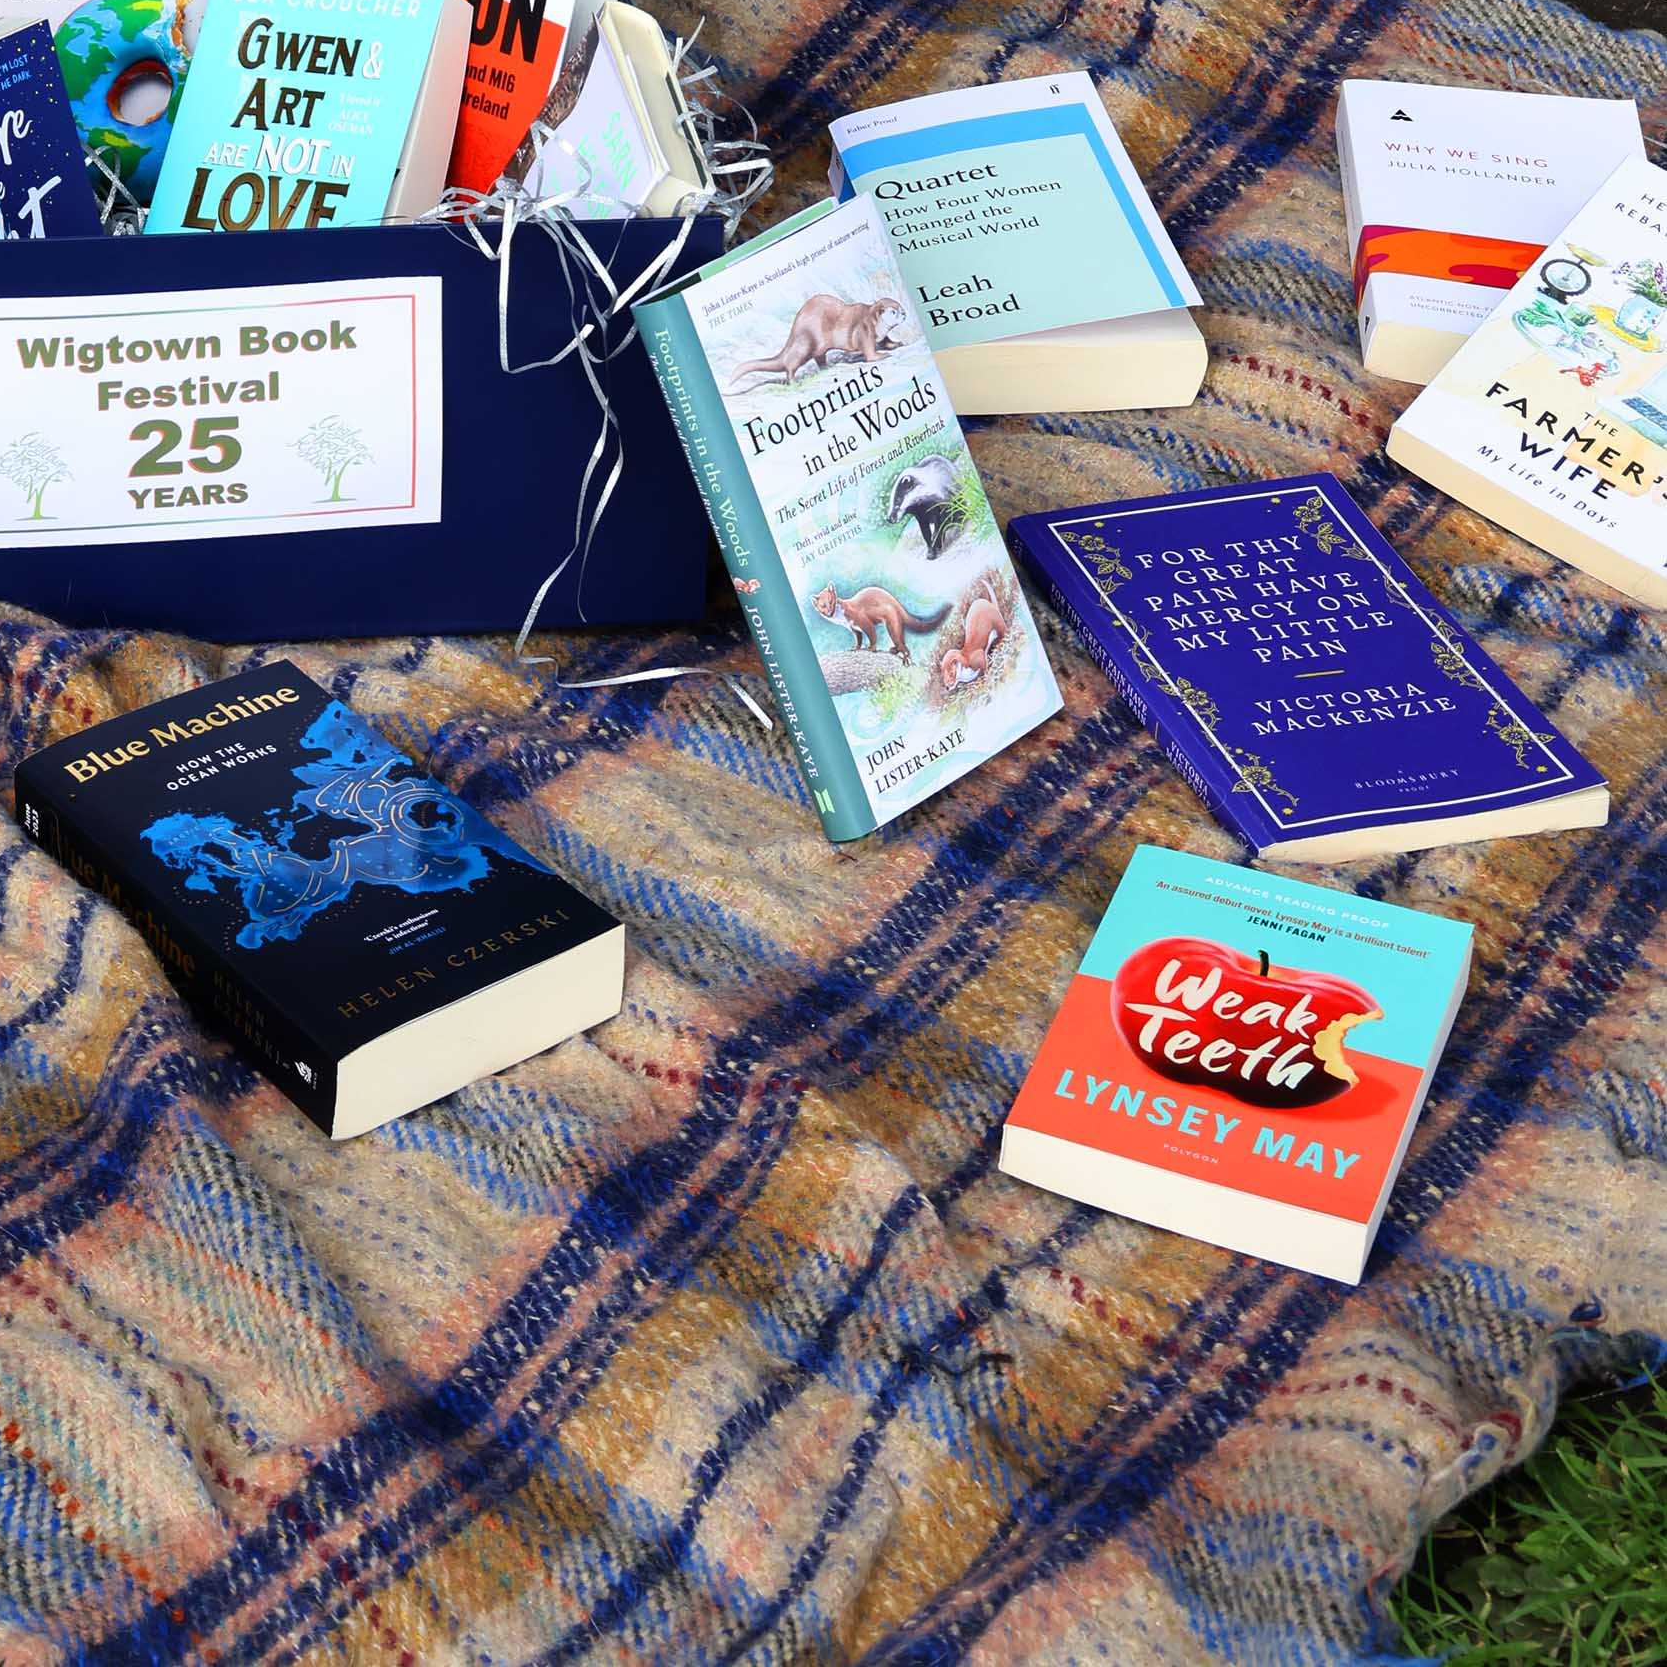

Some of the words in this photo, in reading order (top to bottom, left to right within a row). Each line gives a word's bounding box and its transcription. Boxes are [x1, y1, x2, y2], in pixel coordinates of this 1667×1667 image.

[238, 18, 363, 77] GWEN
[362, 41, 383, 79] &
[231, 78, 326, 131] ART
[203, 142, 250, 167] ARE
[253, 135, 333, 175] NOT
[330, 155, 357, 179] IN
[1384, 142, 1436, 157] WHY
[1446, 147, 1480, 162] WE
[1490, 152, 1549, 169] SING
[1388, 159, 1437, 173] JULIA
[1445, 166, 1557, 187] HOLLANDER
[874, 163, 999, 201] Quartet
[917, 274, 993, 305] Leah
[928, 294, 1021, 328] Broad
[16, 336, 222, 373] Wigtown
[239, 321, 357, 356] Book
[97, 371, 280, 411] Festival
[743, 365, 883, 455] Footprints
[803, 454, 826, 476] in
[828, 434, 858, 462] the
[851, 375, 936, 441] Woods
[1485, 382, 1667, 500] FARMER'
[1583, 412, 1618, 437] THE
[128, 416, 243, 478] 25
[1520, 431, 1616, 499] WIFE
[127, 483, 248, 510] YEARS
[1134, 547, 1216, 569] FOR
[1226, 535, 1303, 558] THY
[1173, 556, 1298, 587] GREAT
[1143, 586, 1238, 612] PAIN
[1260, 572, 1360, 597] HAVE
[1163, 598, 1297, 631] MERCY
[1317, 591, 1372, 611] ON
[1174, 627, 1233, 652] MY
[1248, 611, 1394, 642] LITTLE
[1252, 639, 1348, 665] PAIN
[1251, 697, 1457, 737] MACKENZIE
[1254, 683, 1427, 715] VICTORIA
[62, 735, 151, 785] Blue
[150, 683, 301, 749] Machine
[864, 733, 907, 775] JOHN
[166, 763, 220, 792] OCEAN
[222, 745, 277, 772] WORKS
[176, 751, 217, 776] HOW
[222, 741, 247, 756] THE
[875, 728, 965, 796] LISTER-KAYE
[337, 967, 436, 1021] HELEN
[446, 908, 571, 969] CZERSKI
[1154, 959, 1318, 1039] Weak
[1125, 1003, 1315, 1091] Teeth
[1054, 1068, 1241, 1144] LYNSEY
[1252, 1127, 1361, 1180] MAY
